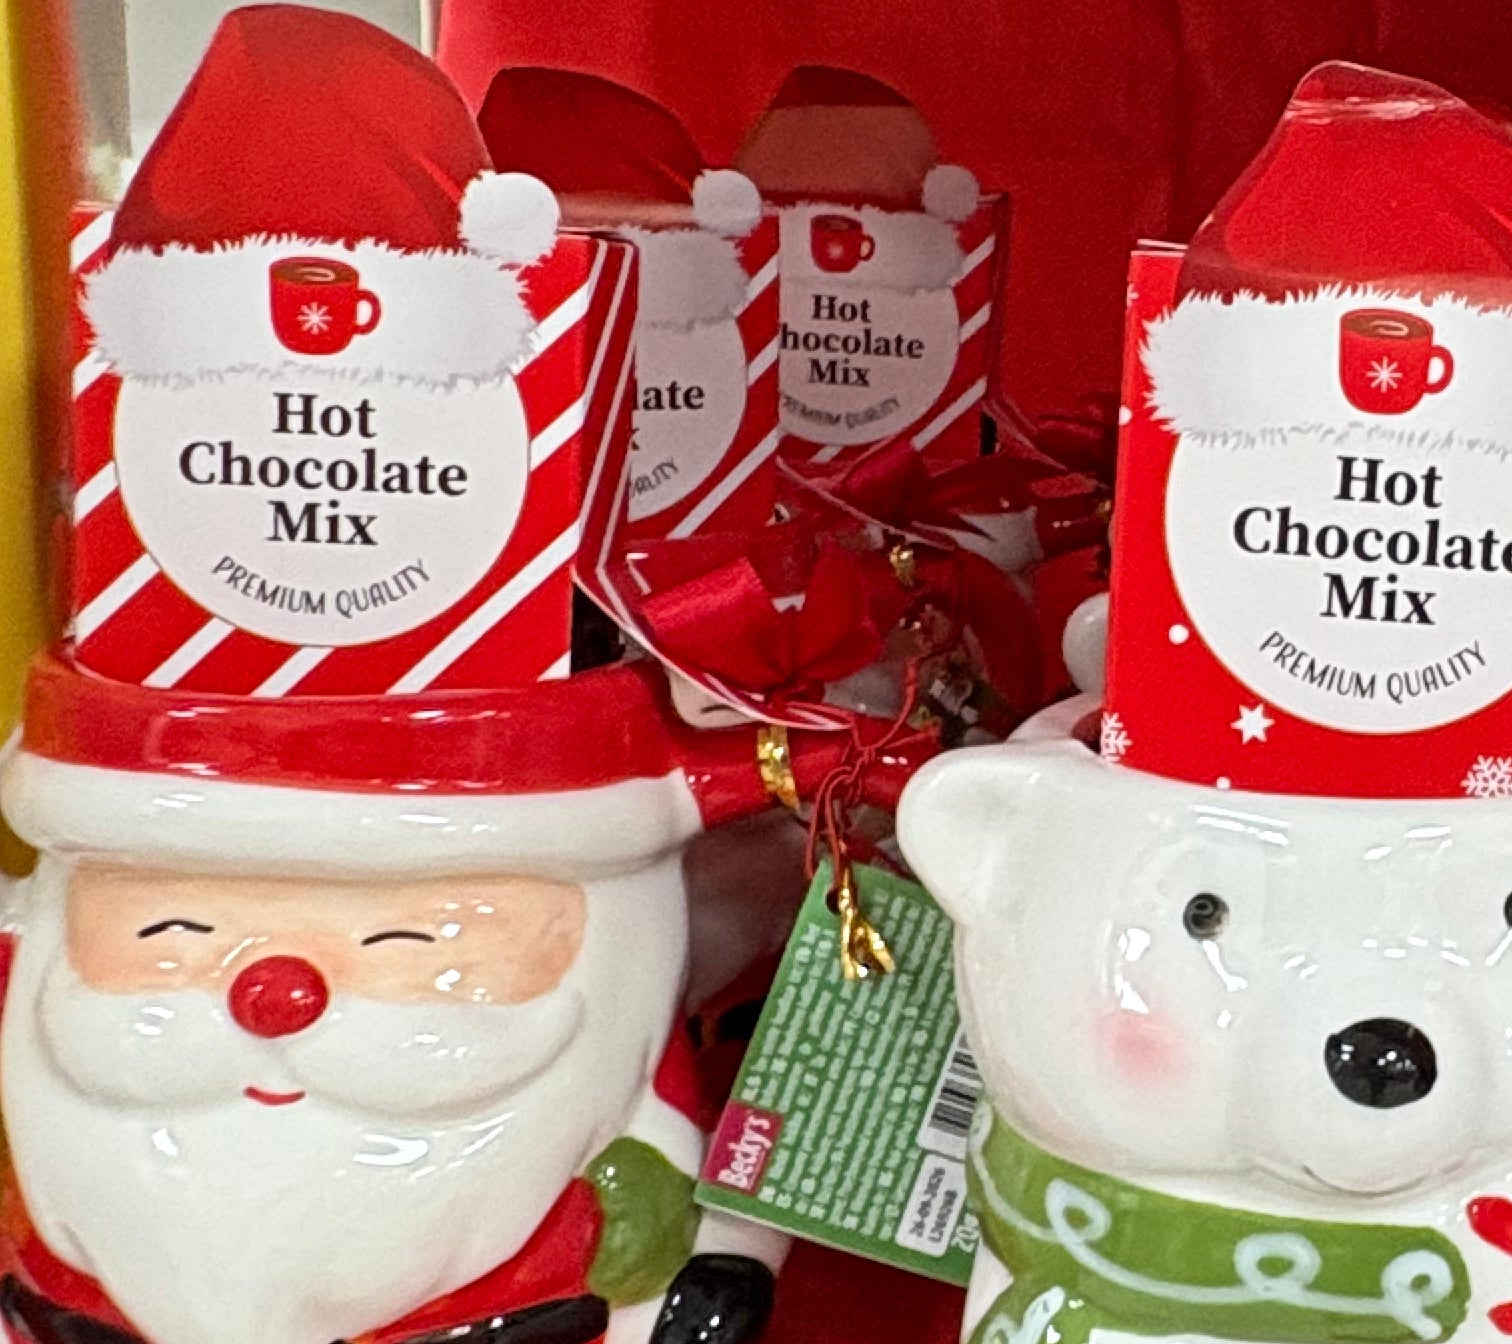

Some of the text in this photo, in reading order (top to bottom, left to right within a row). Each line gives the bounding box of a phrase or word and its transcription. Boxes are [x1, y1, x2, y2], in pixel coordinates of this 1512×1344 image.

[811, 294, 872, 323] Hot
[780, 322, 925, 359] hocolate
[807, 357, 871, 387] Mix
[272, 392, 376, 438] Hot
[179, 441, 468, 497] Chocolate
[1334, 456, 1442, 508] Hot
[267, 499, 378, 546] Mix
[211, 555, 430, 619] PREMIUM QUALITY
[1320, 572, 1436, 626] Mix
[1259, 631, 1487, 704] PREMIUM QUALITY
